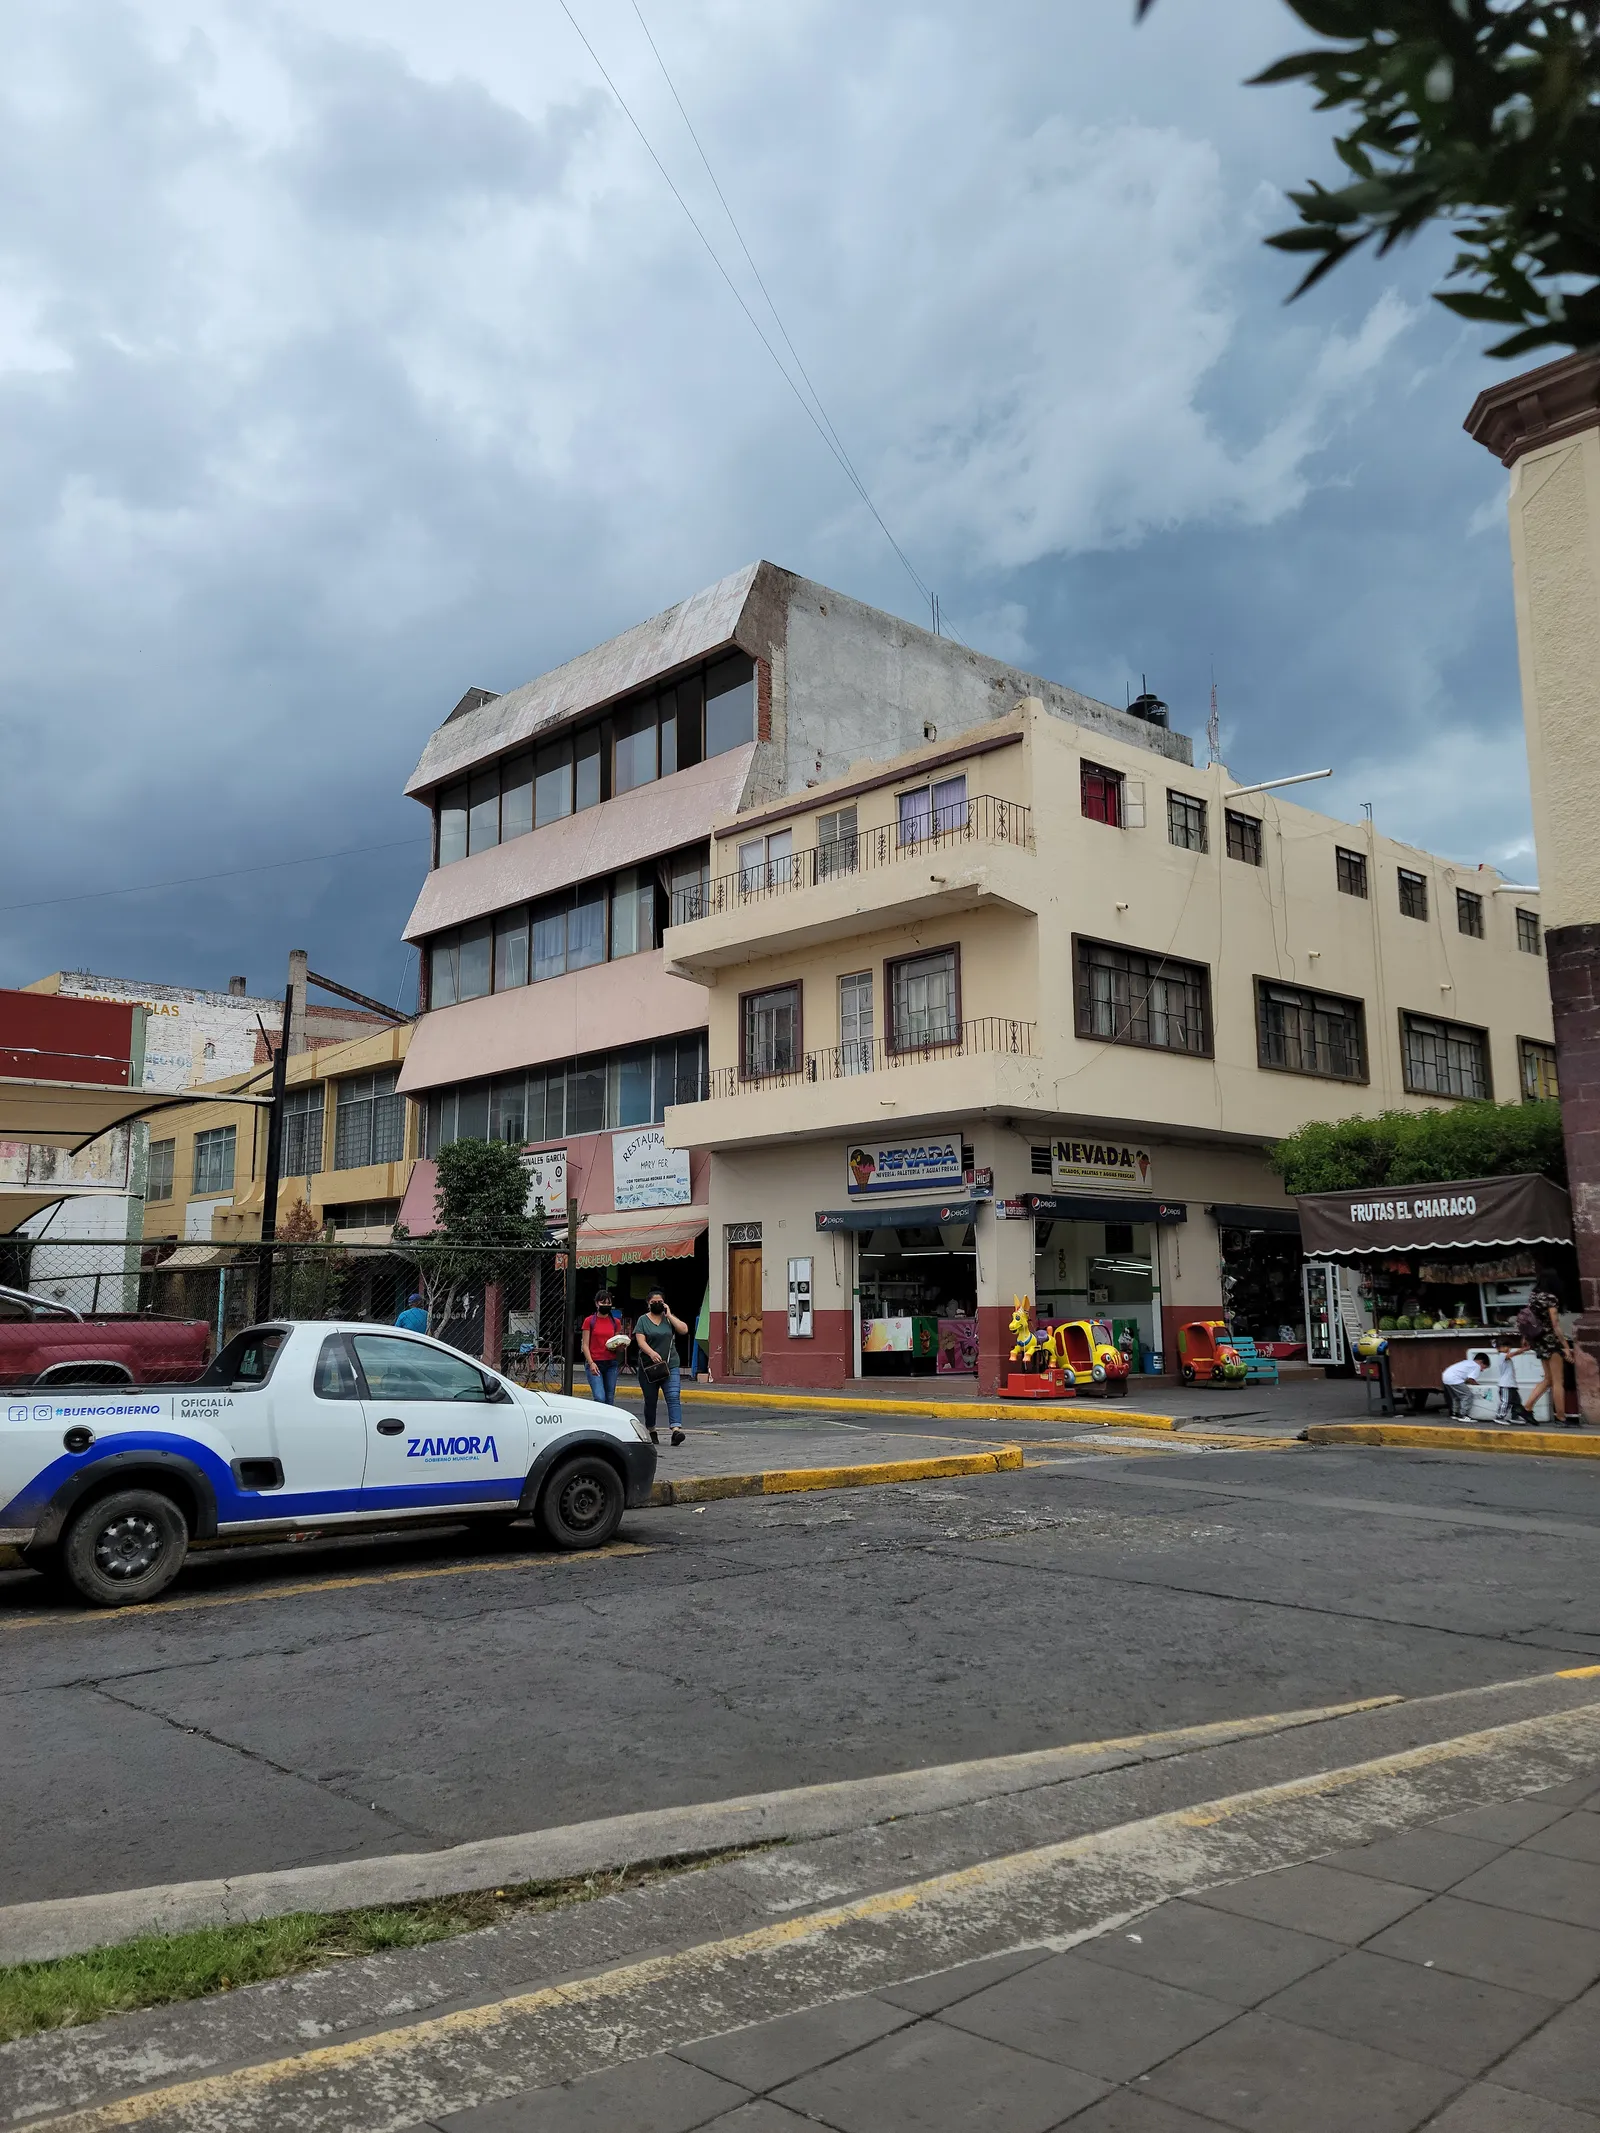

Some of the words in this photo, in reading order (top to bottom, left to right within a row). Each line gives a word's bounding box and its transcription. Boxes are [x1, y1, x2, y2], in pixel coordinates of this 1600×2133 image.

[622, 1133, 676, 1162] RESTAURA
[545, 1152, 566, 1163] GARCÍA
[879, 1144, 959, 1171] NEVADA
[1057, 1141, 1133, 1168] NEVADA
[640, 1160, 656, 1170] MARY
[1040, 1200, 1057, 1209] pepsi
[1350, 1202, 1395, 1222] FRUTAS
[1396, 1201, 1412, 1220] EL
[1413, 1196, 1477, 1219] CHARACO
[949, 1207, 970, 1219] pepsi
[1166, 1208, 1181, 1216] pepsi
[576, 1254, 612, 1265] ONCHERIA
[621, 1251, 641, 1262] MARY
[650, 1247, 666, 1259] FER
[180, 1396, 235, 1408] OFICIALÍA
[55, 1405, 161, 1417] #BUENGOBIERNO
[180, 1408, 220, 1418] MAYOR
[535, 1414, 563, 1425] OM01
[406, 1435, 499, 1463] ZAMORA
